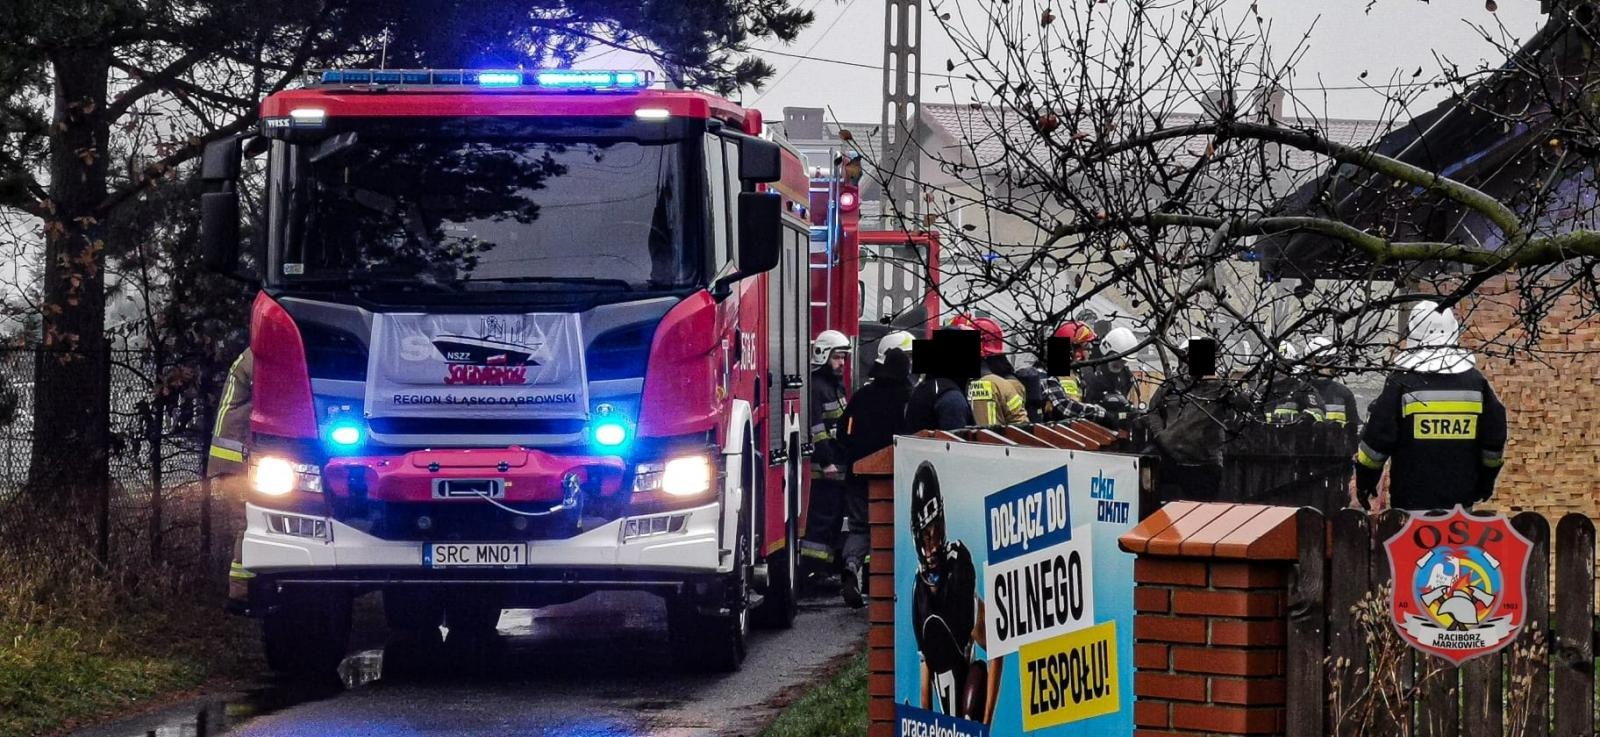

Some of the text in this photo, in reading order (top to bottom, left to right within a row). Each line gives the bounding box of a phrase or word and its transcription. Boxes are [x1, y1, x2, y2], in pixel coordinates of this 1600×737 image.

[447, 352, 471, 360] NSZZ
[394, 394, 441, 405] REGION
[990, 484, 1067, 550] DOŁĄCZ DO
[436, 546, 519, 563] SRC MN01
[994, 550, 1083, 642] SILNEGO
[1027, 640, 1110, 716] ZESPOŁU!
